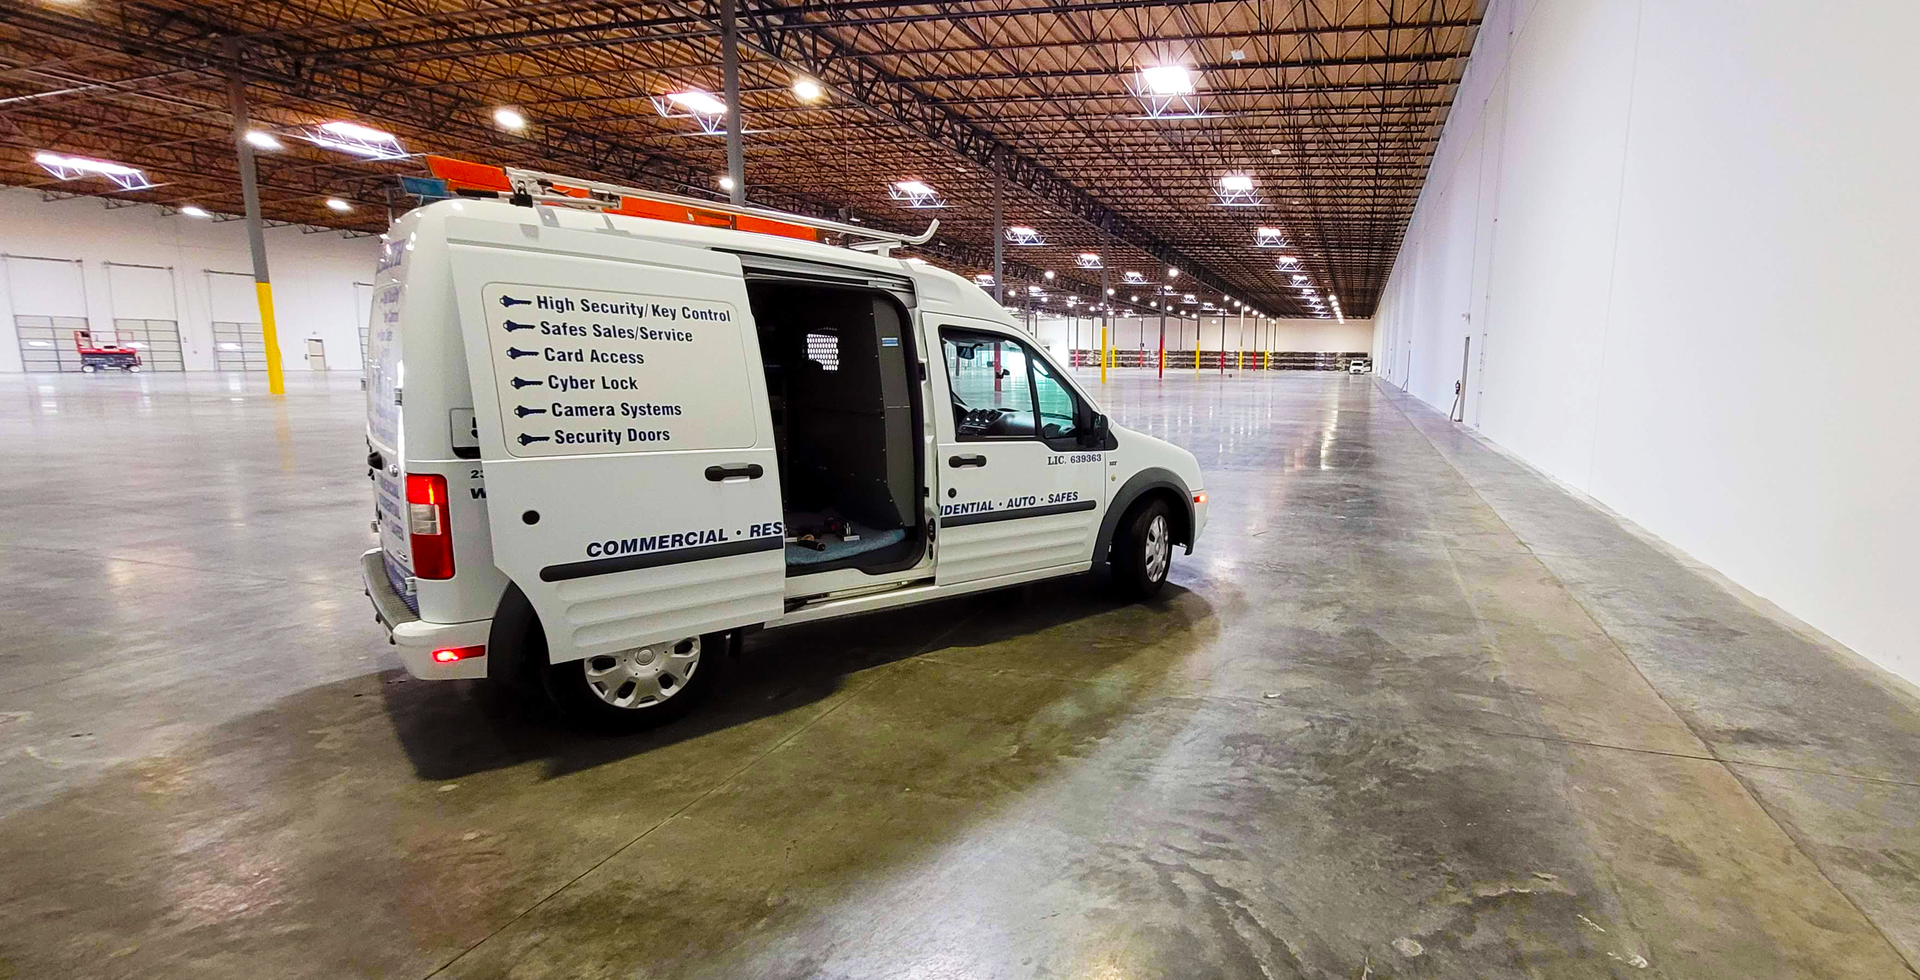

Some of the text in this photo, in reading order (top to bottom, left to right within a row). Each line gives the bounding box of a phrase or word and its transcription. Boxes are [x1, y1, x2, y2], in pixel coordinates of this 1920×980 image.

[536, 295, 575, 313] High
[652, 304, 677, 321] Key
[682, 306, 731, 322] Control
[540, 321, 693, 342] Safes Sales/Service
[544, 347, 645, 364] Card Access
[548, 375, 639, 392] Cyber Lock
[551, 402, 682, 419] Camera Systems
[554, 427, 671, 446] Security Doors
[1047, 455, 1067, 465] LIC.
[1070, 453, 1102, 464] 639363
[940, 491, 1079, 516] IDENTIAL AUTO SAFES
[586, 521, 783, 557] COMMERCIAL RES
